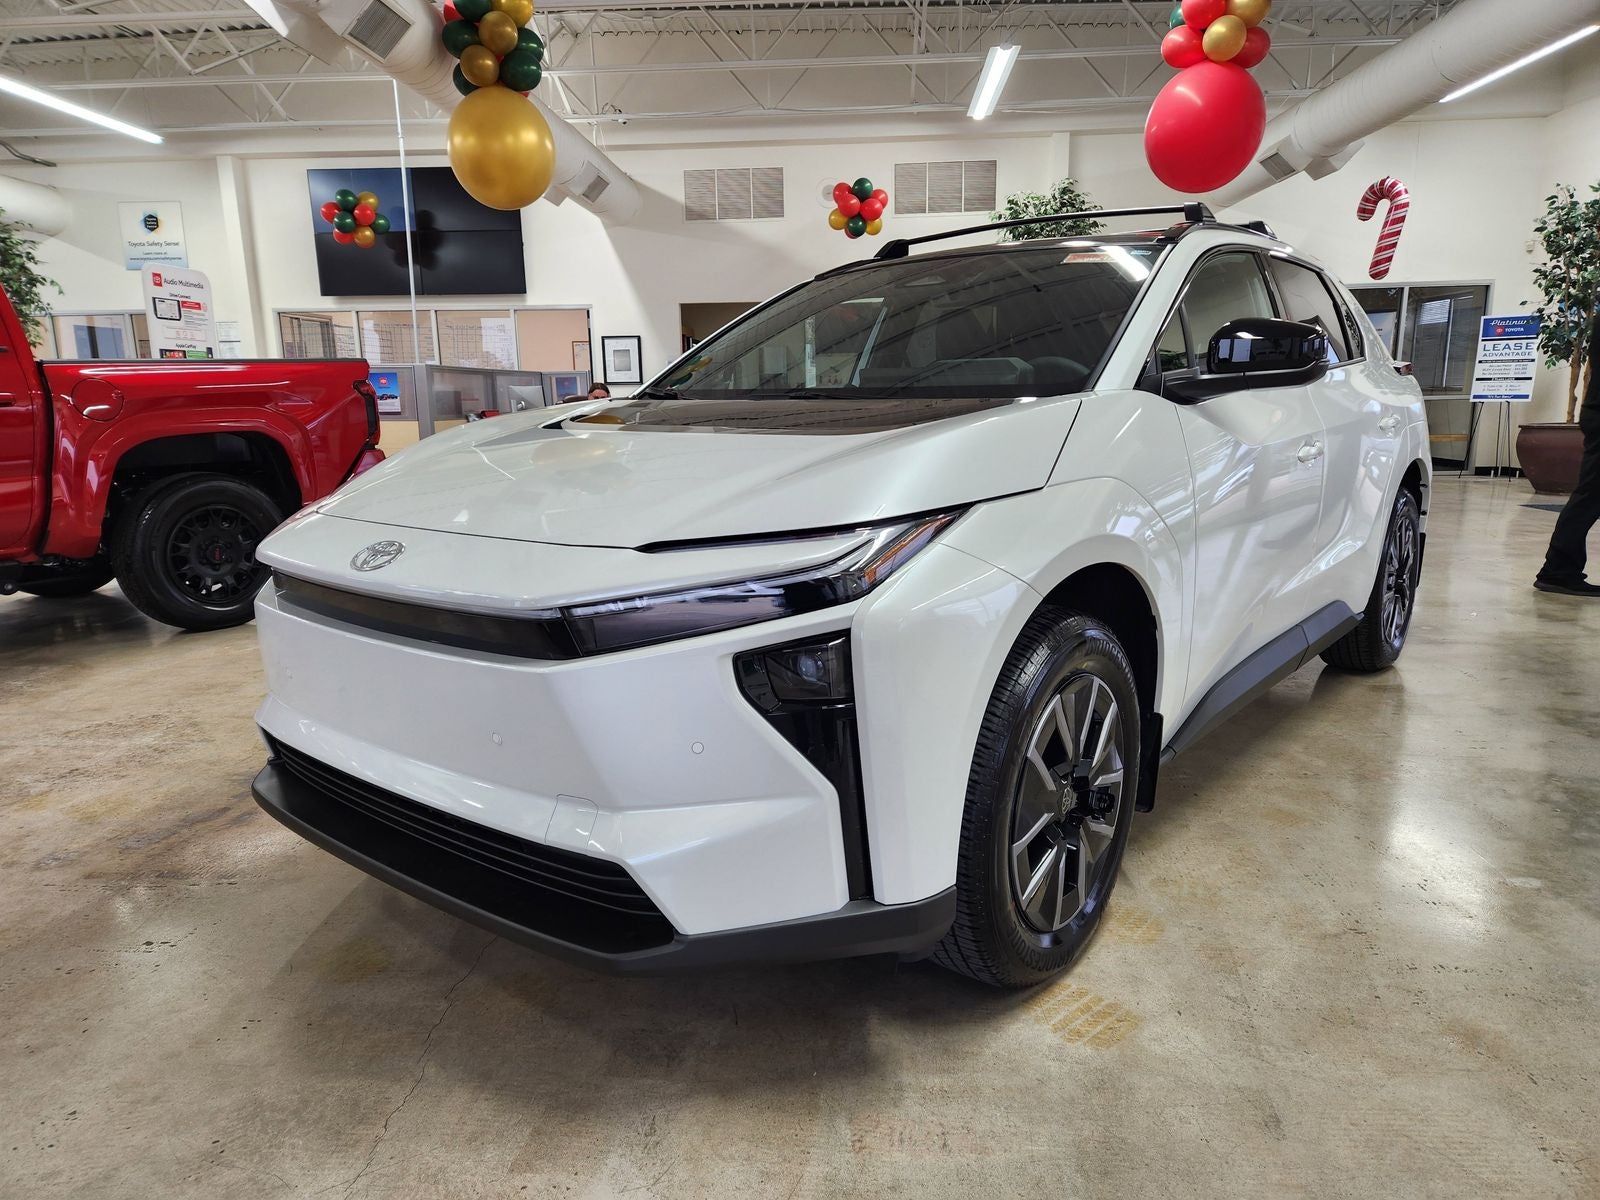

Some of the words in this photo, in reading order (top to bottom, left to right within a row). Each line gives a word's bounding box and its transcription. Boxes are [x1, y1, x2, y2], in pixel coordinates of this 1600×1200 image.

[146, 240, 163, 248] Safety
[163, 278, 178, 286] Audio
[178, 279, 204, 289] Multimedia
[1482, 342, 1535, 352] LEASE
